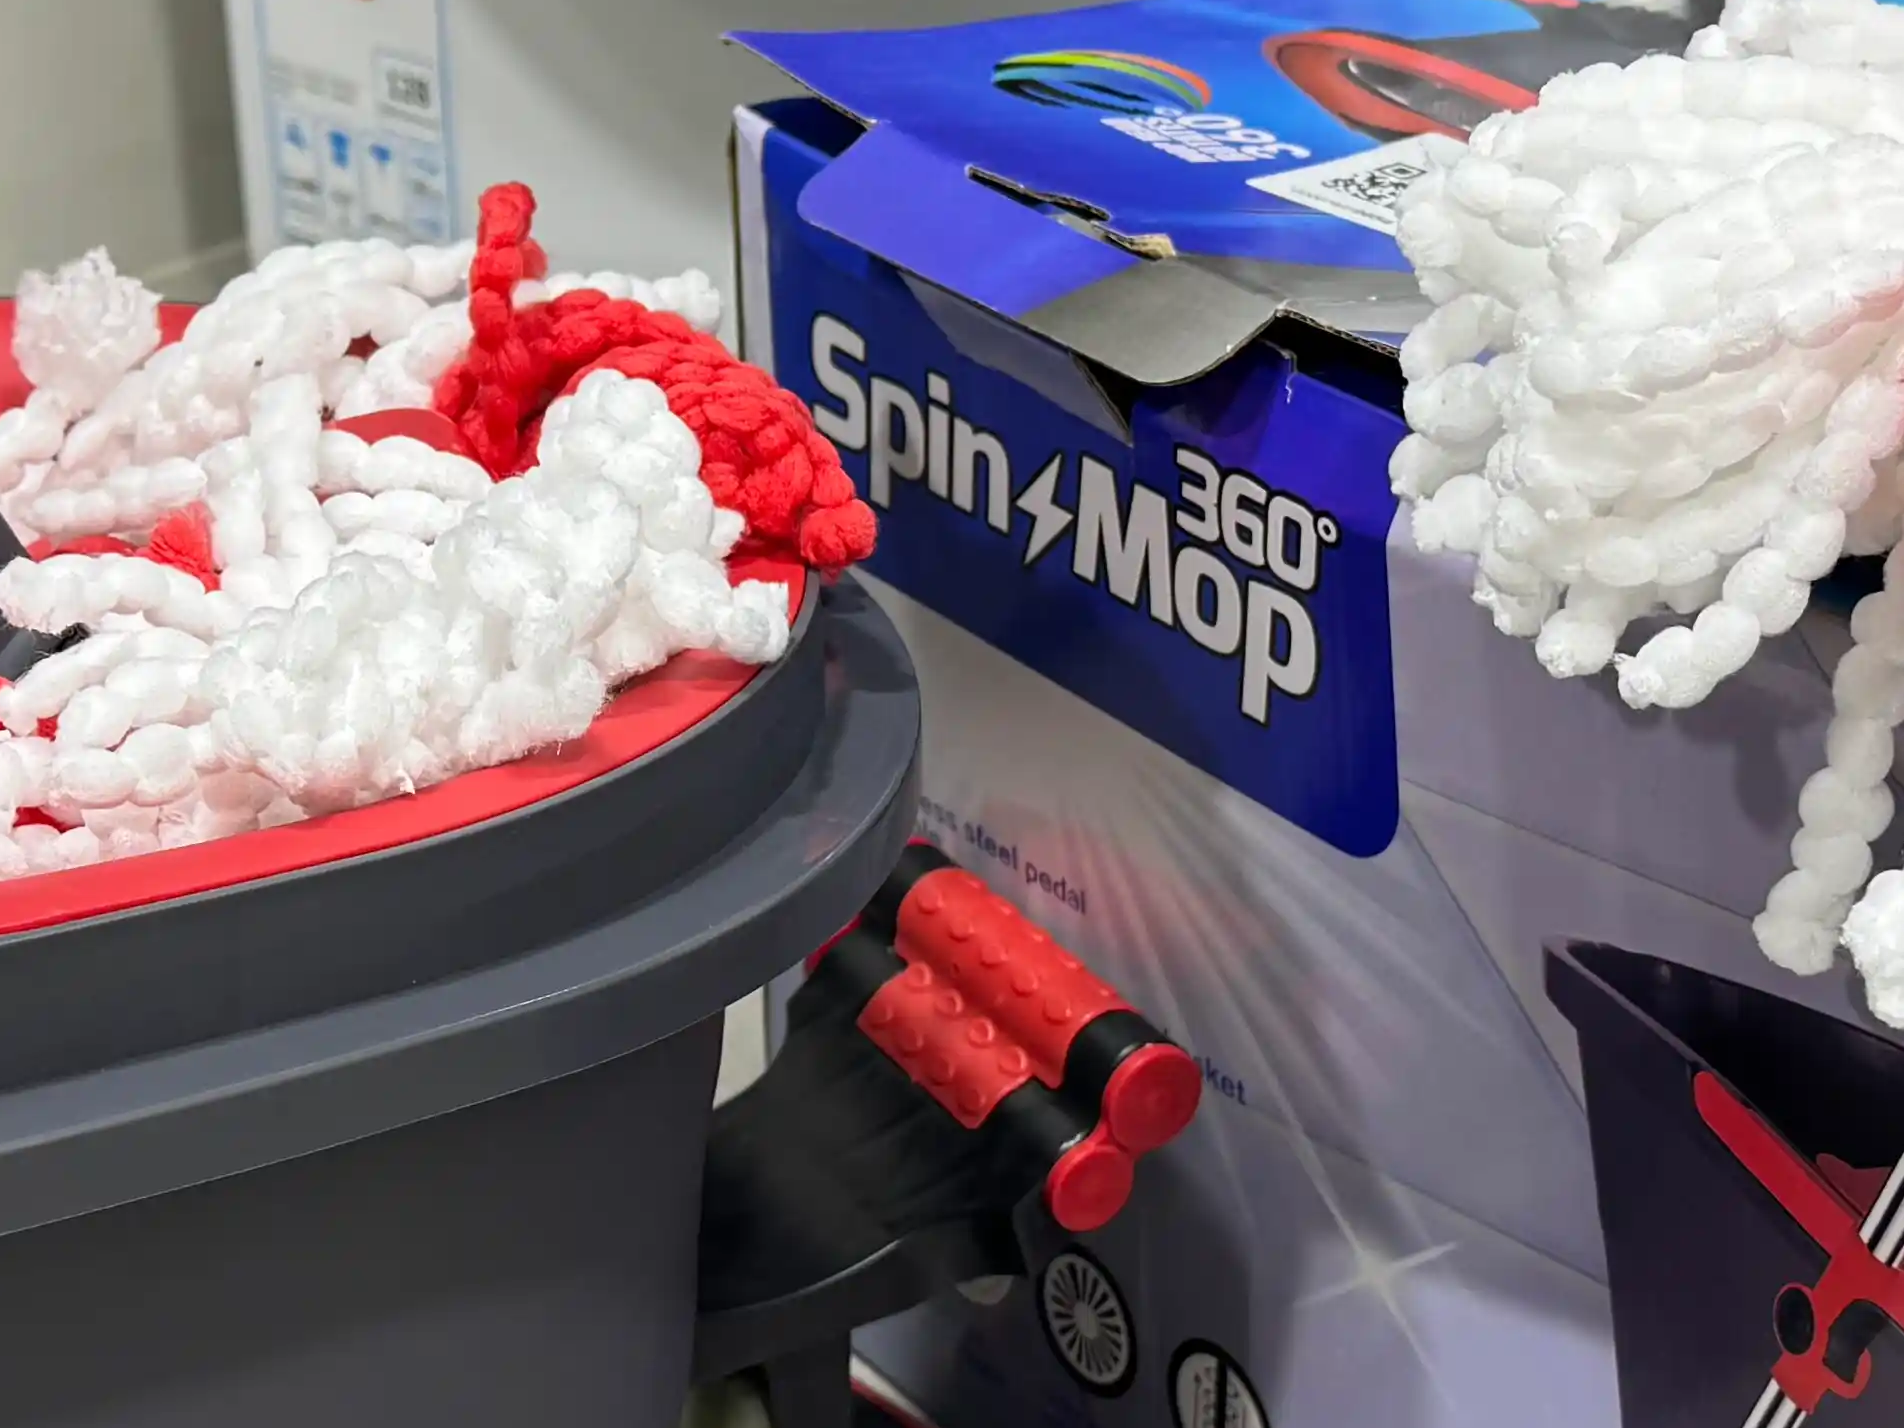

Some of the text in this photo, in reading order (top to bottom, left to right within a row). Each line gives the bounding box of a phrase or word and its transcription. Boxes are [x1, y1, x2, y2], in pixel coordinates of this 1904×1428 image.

[809, 311, 1319, 725] Spin Mop
[1175, 446, 1340, 592] 360°
[963, 821, 1087, 915] steel pedal
